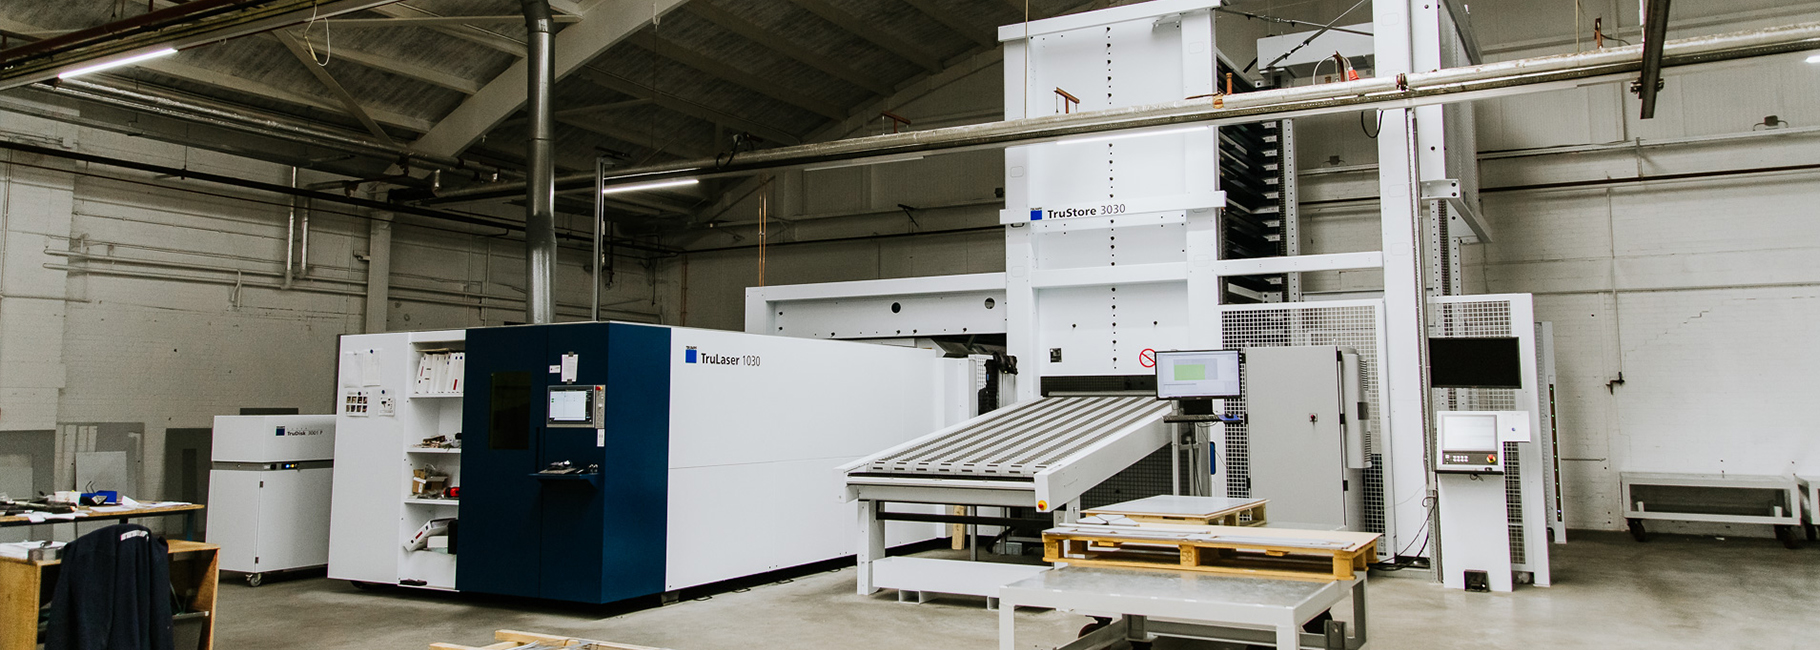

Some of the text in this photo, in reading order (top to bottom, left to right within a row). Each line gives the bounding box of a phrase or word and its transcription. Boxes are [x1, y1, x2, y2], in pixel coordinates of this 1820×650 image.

[1047, 203, 1126, 219] TruStore 3030
[701, 352, 761, 367] TruLaser 1030
